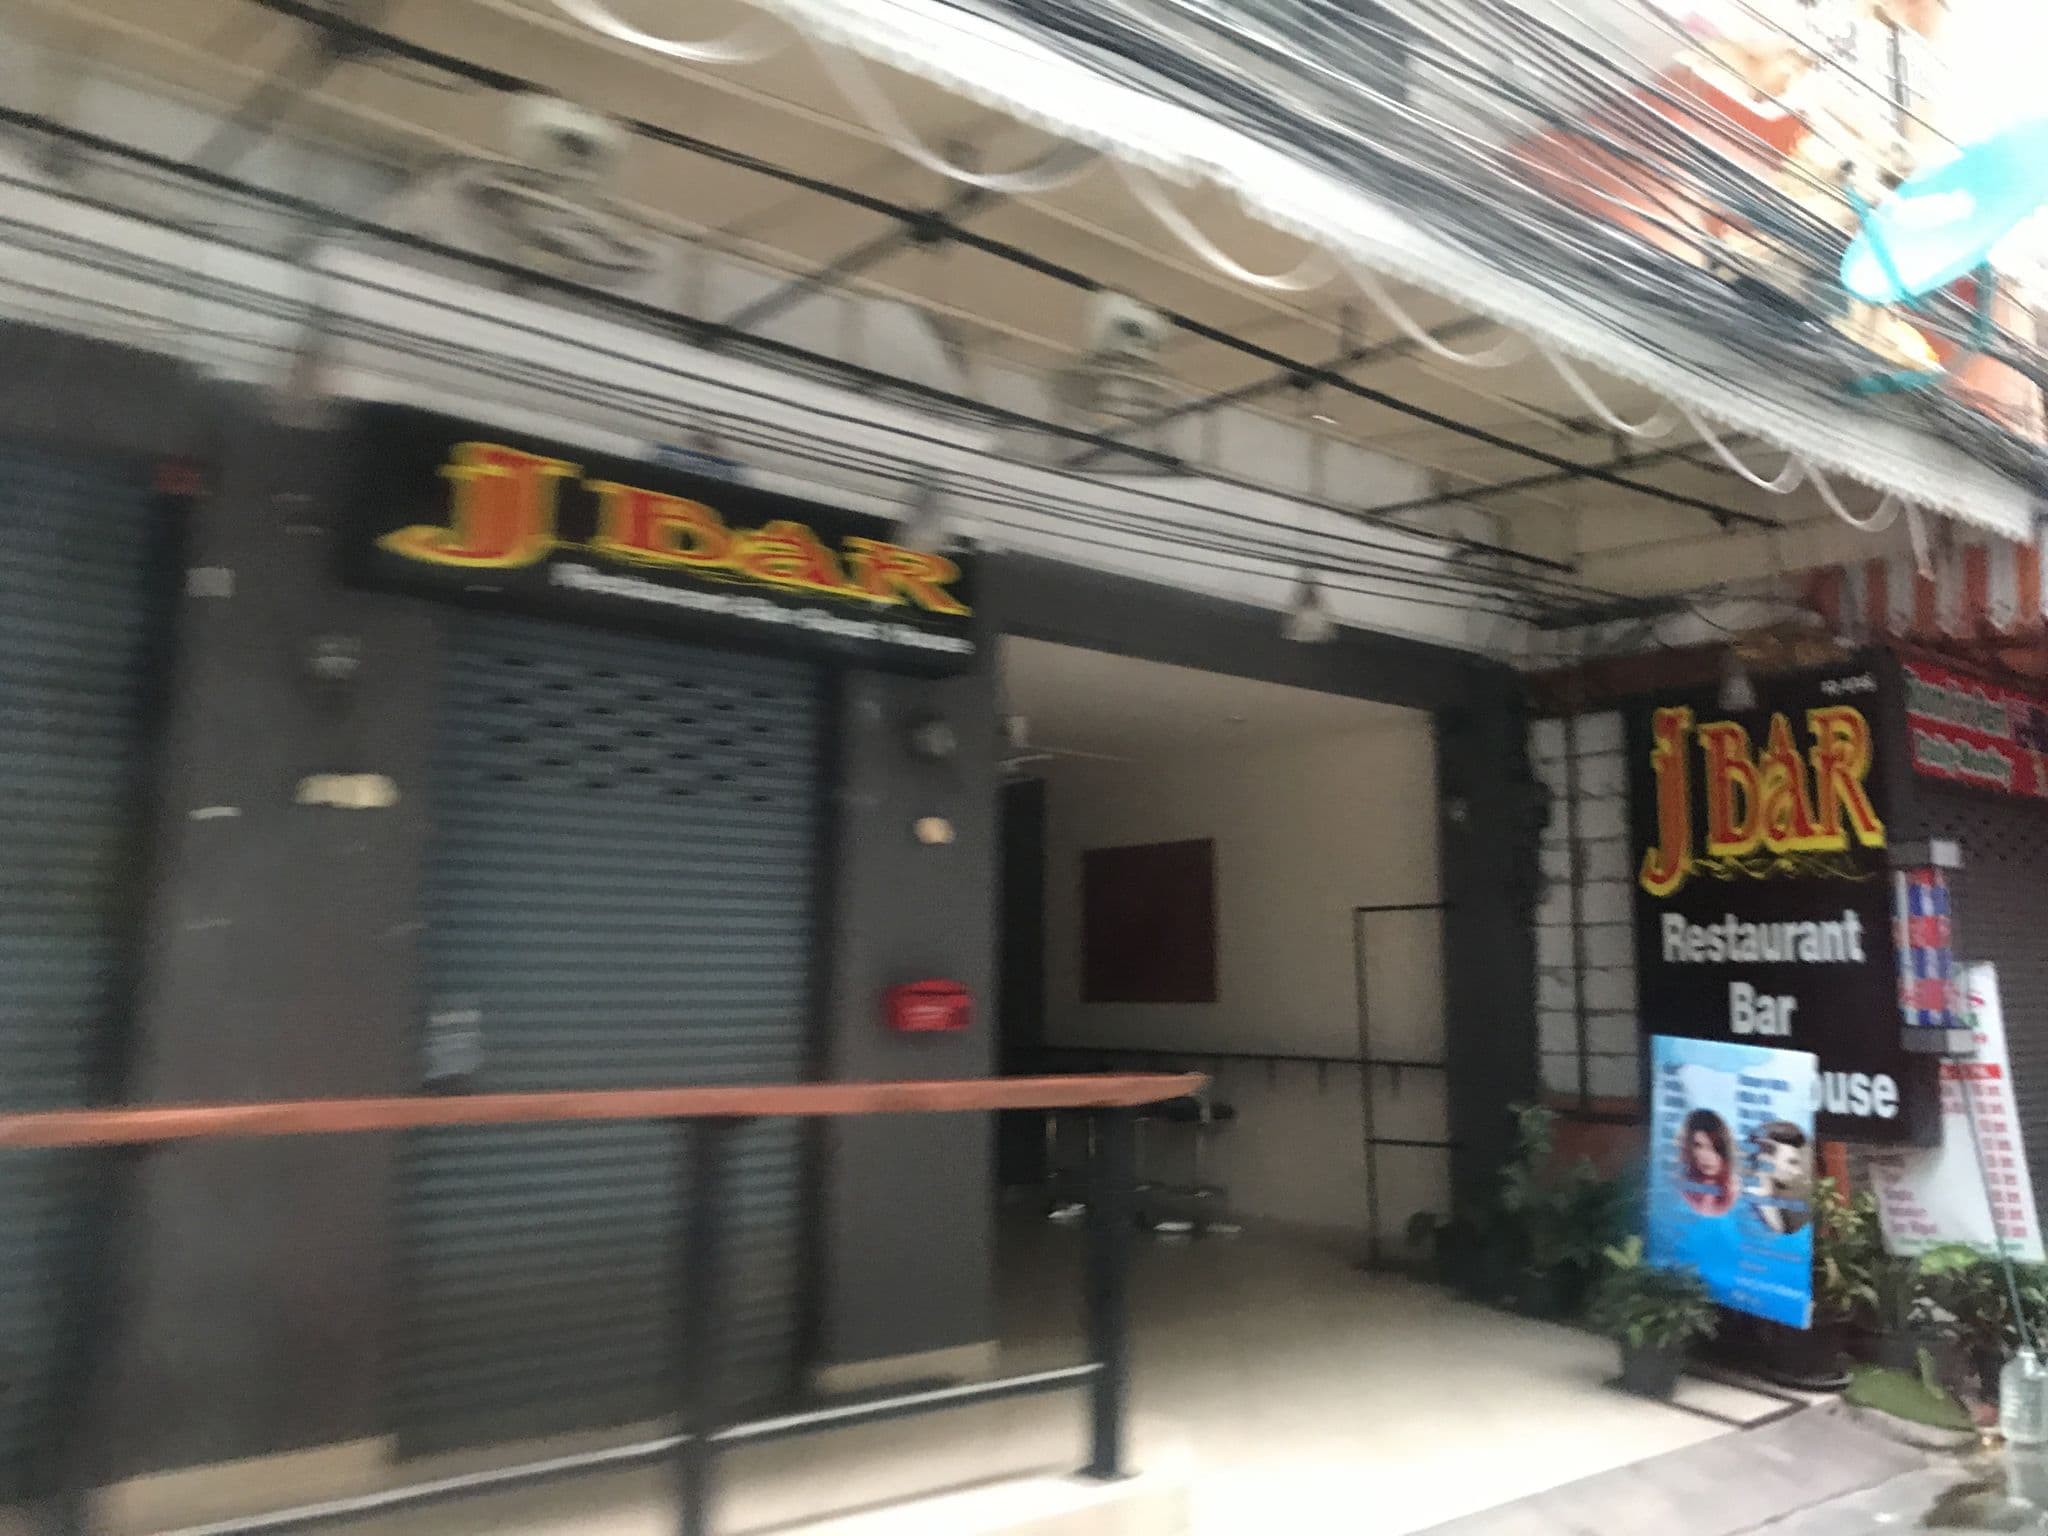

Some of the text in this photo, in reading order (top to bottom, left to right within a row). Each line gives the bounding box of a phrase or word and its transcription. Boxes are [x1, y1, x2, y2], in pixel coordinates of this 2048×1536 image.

[376, 441, 584, 568] J
[1640, 705, 1693, 897] J
[1660, 909, 1866, 963] Restaurant
[1728, 981, 1797, 1036] Bar
